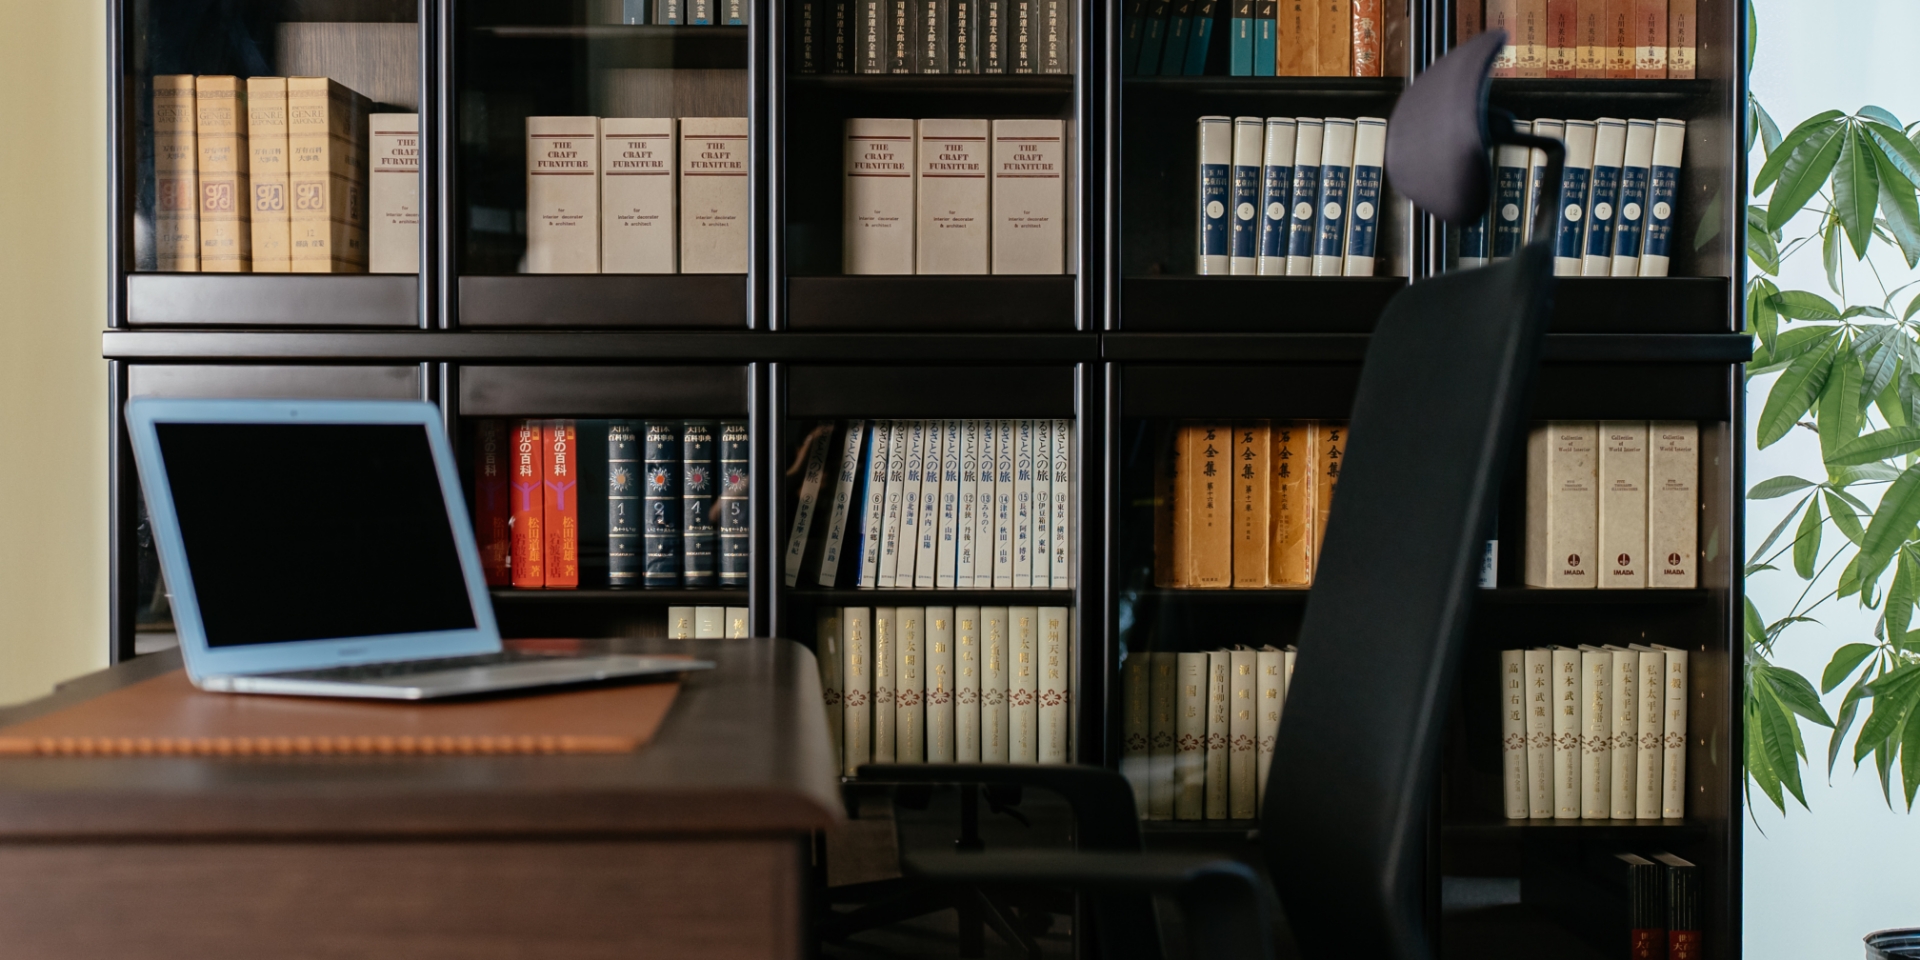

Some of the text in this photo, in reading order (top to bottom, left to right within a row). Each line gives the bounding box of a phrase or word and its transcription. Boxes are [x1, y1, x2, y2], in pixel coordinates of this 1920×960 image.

[1203, 4, 1211, 13] 4
[1241, 4, 1248, 14] 4
[1263, 5, 1270, 15] 4
[251, 111, 283, 119] GENRE
[292, 110, 324, 118] GENRE
[855, 162, 904, 170] FURNITURE
[307, 229, 314, 237] 12
[1658, 207, 1667, 215] 10
[840, 420, 864, 482] るさとへの旅
[873, 420, 889, 482] るさとへの旅
[890, 420, 905, 482] るさとへの旅
[908, 420, 922, 482] るさとへの旅
[926, 420, 939, 482] るさとへの旅
[945, 420, 957, 482] るさとへの旅
[964, 420, 976, 482] るさとへの旅
[981, 420, 993, 482] るさとへの旅
[999, 420, 1011, 482] るさとへの旅
[1018, 420, 1030, 481] るさとへの旅
[1036, 420, 1049, 481] るさとへの旅
[1055, 420, 1068, 482] るさとへの旅
[1203, 429, 1219, 477] 石全集
[1241, 432, 1256, 479] 石全集
[1278, 431, 1293, 479] 石全集
[1327, 430, 1342, 478] 石全集
[617, 503, 625, 515] 1
[654, 502, 664, 515] 2
[731, 502, 740, 515] 5
[528, 516, 540, 577] 松田道雄 著
[562, 516, 575, 576] 松田道雄 著
[1239, 664, 1250, 721] 源頼朝
[1266, 665, 1278, 722] 紅騎兵
[1508, 662, 1521, 721] 高山右近
[1534, 663, 1546, 717] 宮本武蔵
[1563, 662, 1574, 716] 宮本武蔵
[1620, 662, 1632, 722] 私本太平記
[1646, 664, 1657, 724] 私本太平記
